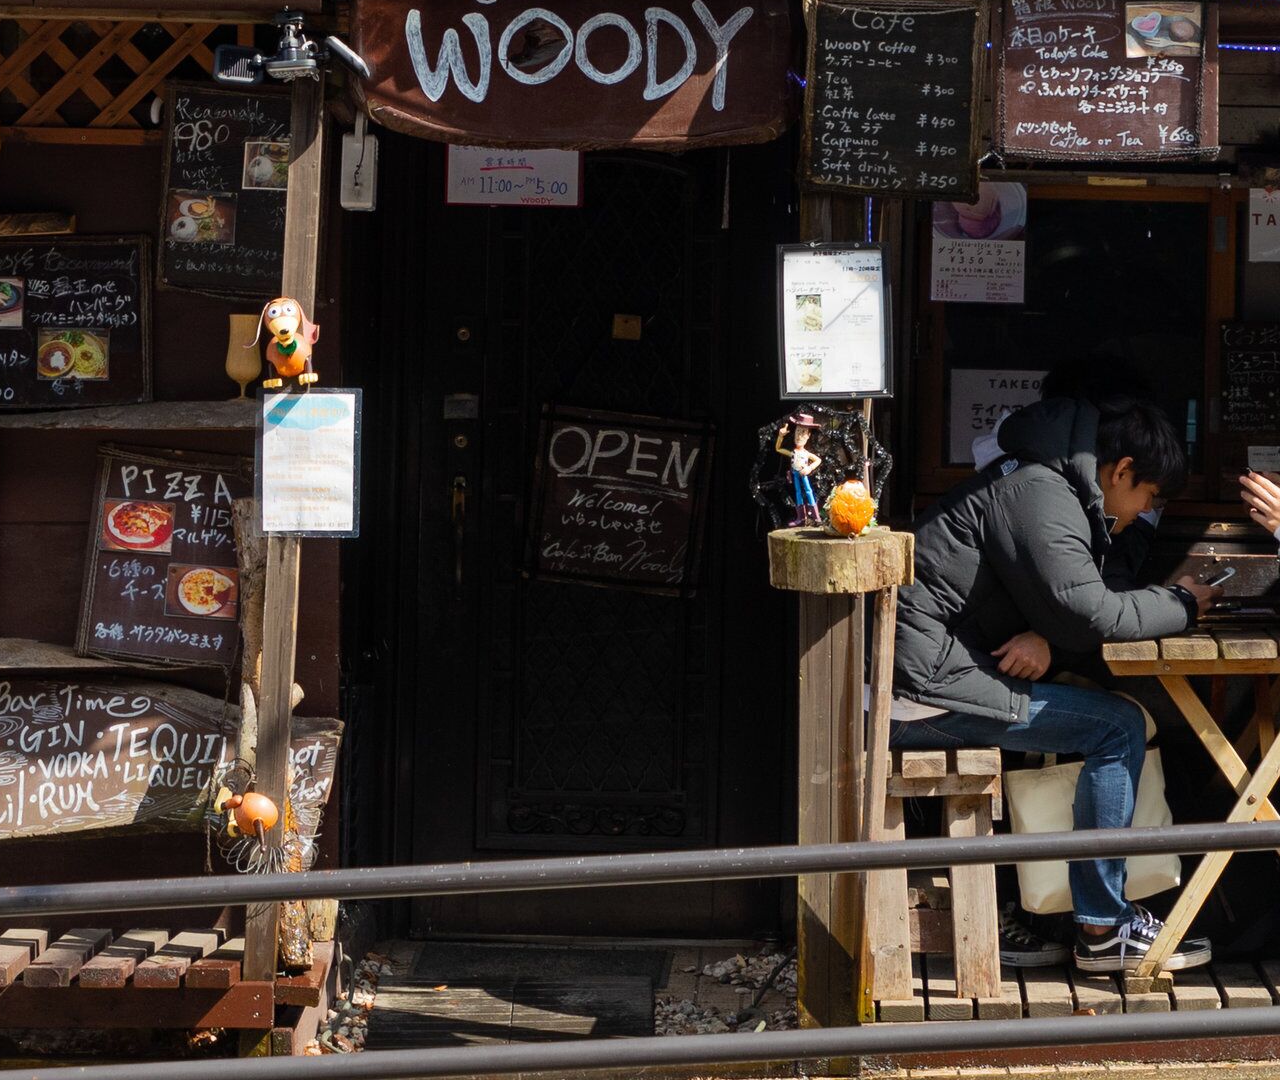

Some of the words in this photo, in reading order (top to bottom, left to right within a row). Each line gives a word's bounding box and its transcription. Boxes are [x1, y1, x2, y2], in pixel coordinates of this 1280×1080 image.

[851, 10, 915, 35] Cafe
[1009, 25, 1097, 48] 本日のケーキ
[824, 39, 871, 53] WOODY
[877, 41, 918, 54] Coffee
[1035, 46, 1078, 64] Today's
[1080, 44, 1109, 60] Cake
[825, 53, 903, 69] ウッディーコーヒー
[924, 52, 959, 67] ¥300
[825, 71, 850, 86] Tea
[824, 86, 855, 101] 紅茶
[921, 82, 956, 97] ¥300
[824, 121, 852, 134] カフェ
[861, 122, 884, 135] ラテ
[915, 113, 957, 129] ¥450
[1015, 120, 1078, 135] ドリンクセット
[1049, 129, 1092, 149] Coffee
[1097, 136, 1113, 146] or
[1116, 130, 1144, 146] Tea
[1158, 123, 1196, 145] ¥650
[914, 141, 958, 157] ¥450
[821, 158, 852, 171] Soft
[858, 161, 898, 175] drink
[460, 176, 475, 185] AM
[535, 177, 568, 195] 5:00
[915, 171, 958, 188] ¥250
[521, 196, 554, 205] WOODY
[950, 255, 985, 265] ¥350
[70, 295, 132, 312] ハンバーグ
[548, 426, 701, 490] OPEN
[120, 465, 234, 505] PIZZA
[567, 488, 664, 517] Welcome!
[191, 503, 234, 527] ¥115
[561, 512, 664, 535] いらっしゃいませ
[120, 576, 168, 602] チーズ
[19, 720, 86, 754] GIN
[36, 749, 110, 781] VODKA
[37, 780, 101, 819] RUM
